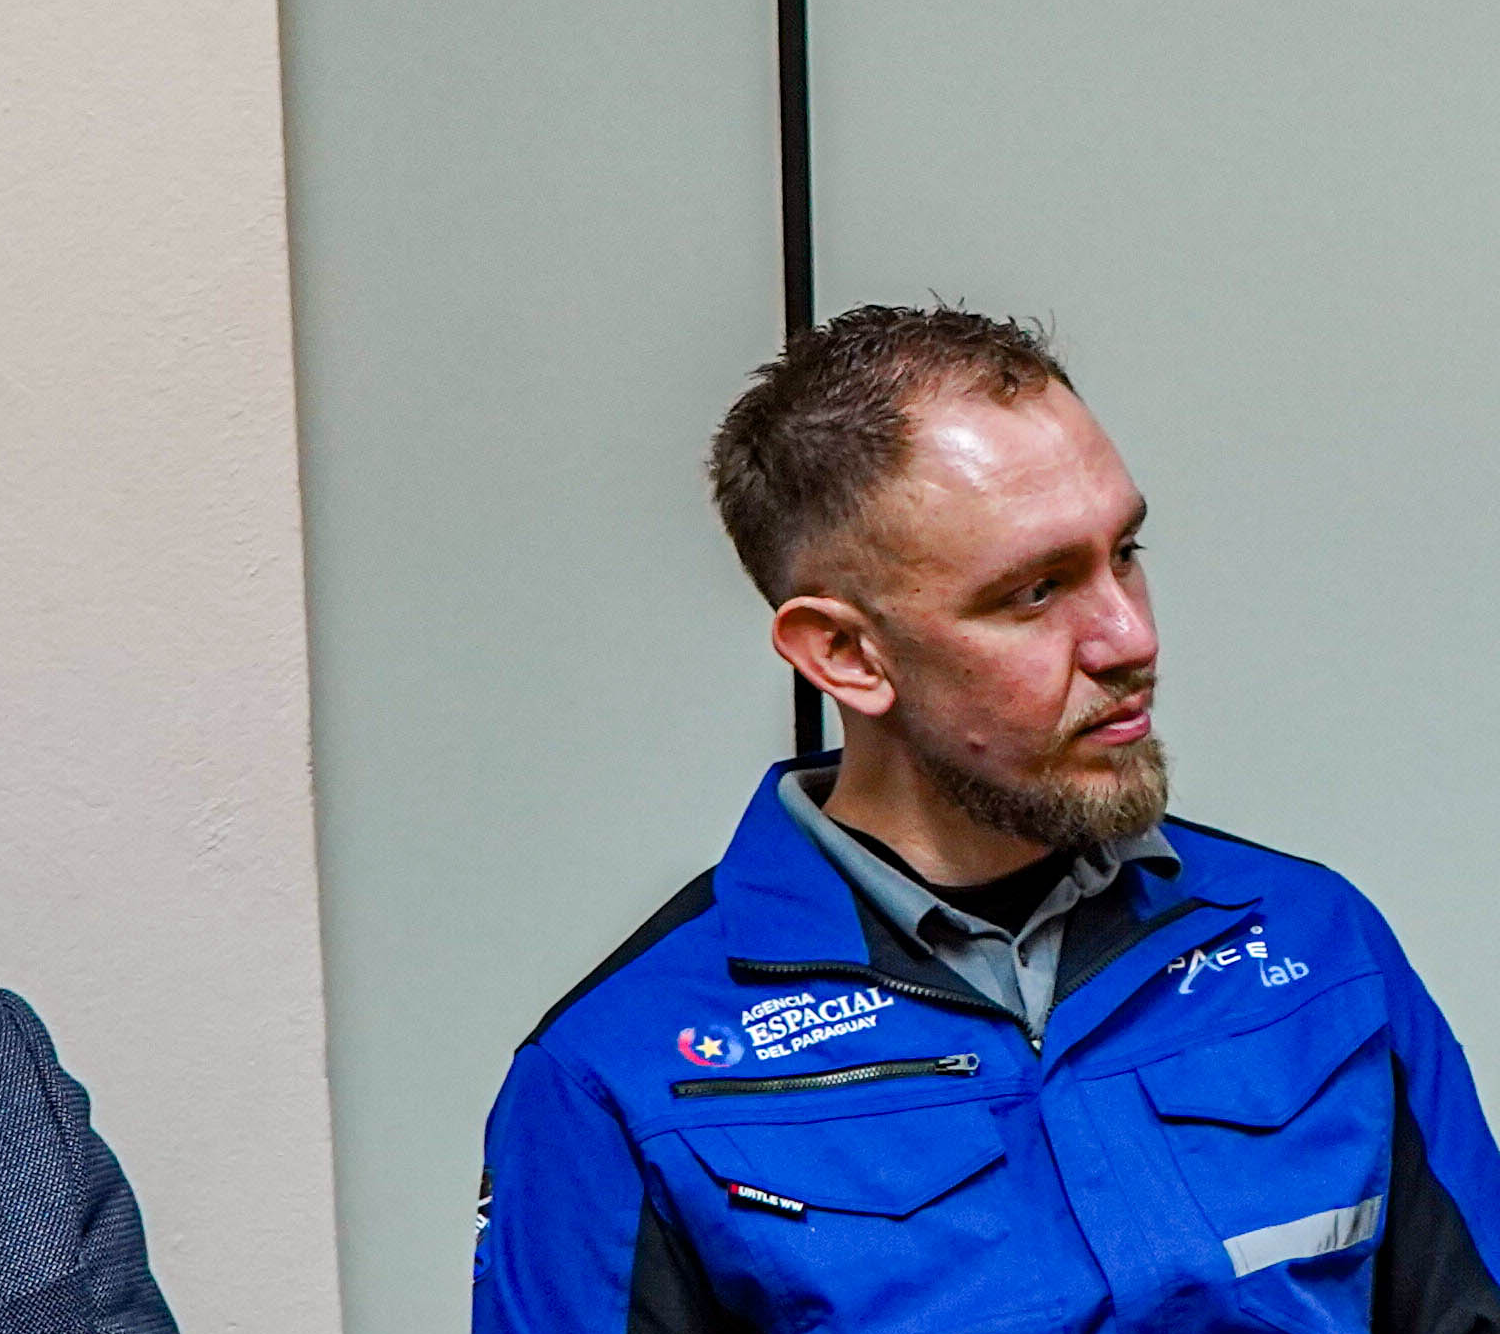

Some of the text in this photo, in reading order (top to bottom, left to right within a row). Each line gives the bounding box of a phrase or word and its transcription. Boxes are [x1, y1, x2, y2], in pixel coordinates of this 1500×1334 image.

[741, 992, 816, 1026] AGENCIA
[745, 985, 895, 1047] ESPACIAL
[755, 1014, 877, 1061] DEL PARAGUAY
